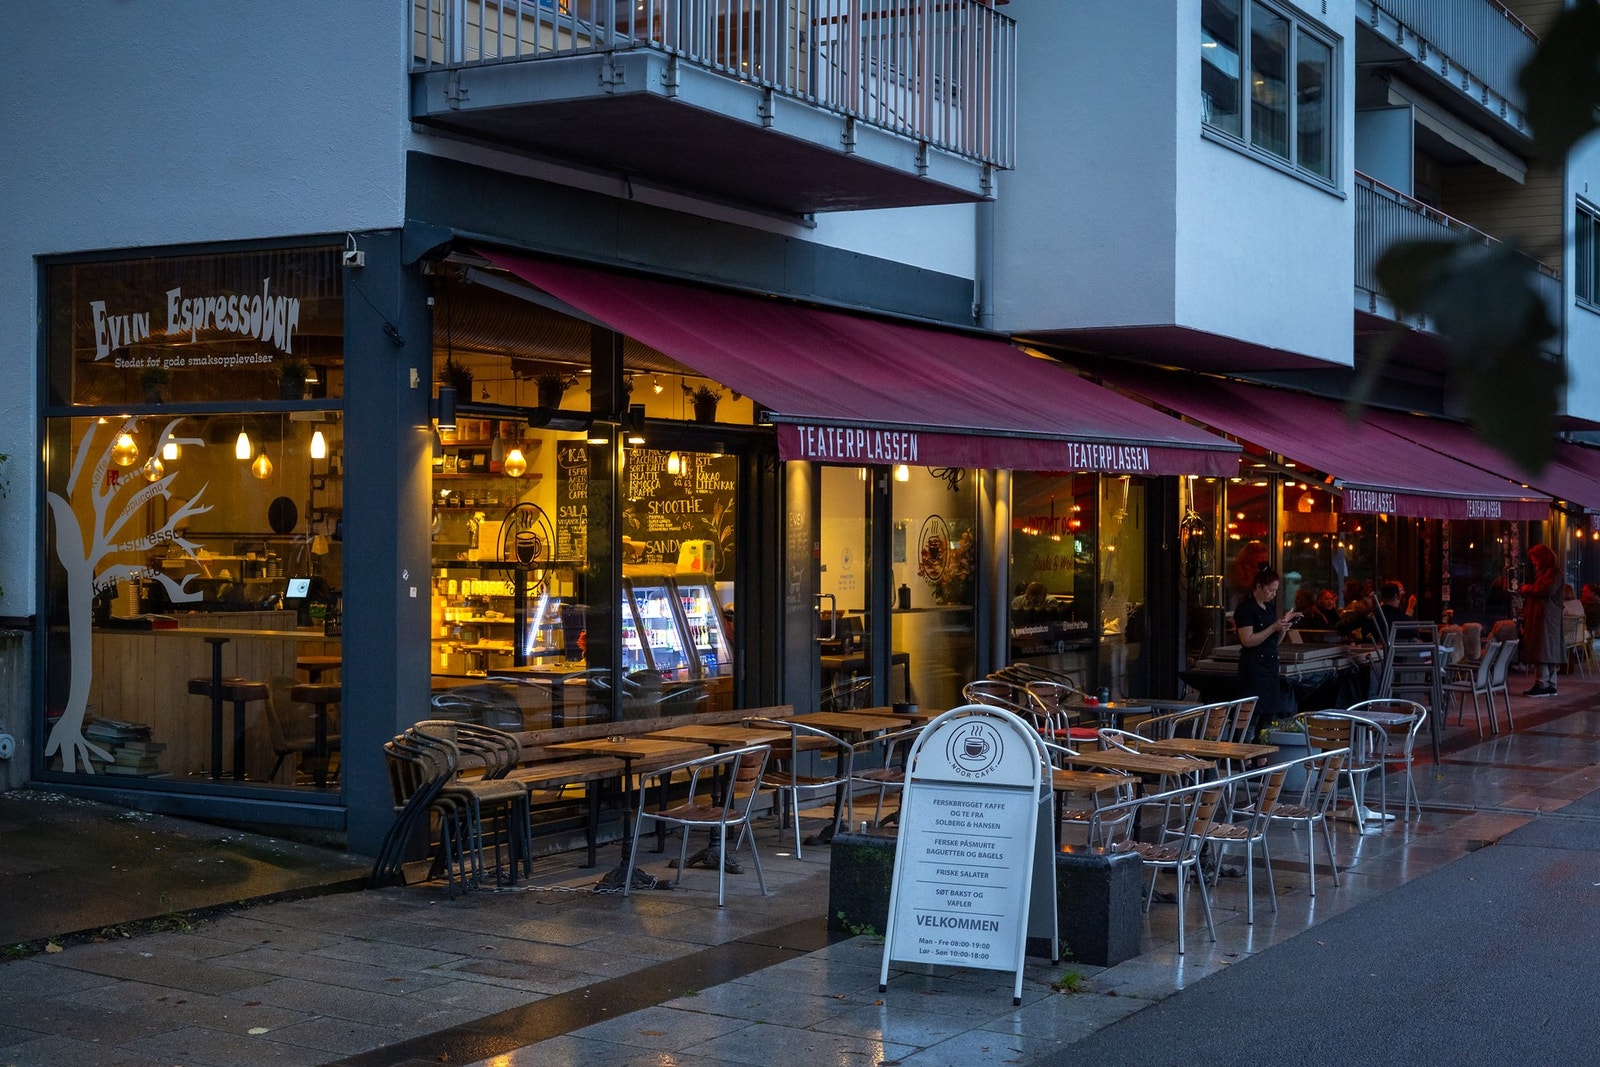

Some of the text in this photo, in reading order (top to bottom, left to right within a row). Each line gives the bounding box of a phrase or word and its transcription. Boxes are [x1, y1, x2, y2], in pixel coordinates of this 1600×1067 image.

[165, 277, 300, 354] Espressobar
[114, 353, 274, 370] Stedet for gode smaksopplevelser
[797, 425, 918, 462] TEATERPLASSEN
[1067, 442, 1149, 471] TEATERPLASSEN
[696, 472, 721, 482] KAKAO
[951, 763, 971, 778] NOOR
[933, 799, 1005, 810] FERSKBRYGGET KAFFE
[935, 819, 965, 827] SOLBERG
[973, 822, 1001, 830] HANSEN
[934, 839, 995, 849] FERSKE PÅSMURTE
[926, 848, 965, 857] BAGUETTER
[978, 851, 1003, 860] BAGELS
[936, 868, 989, 879] FRISKE SALATER
[950, 889, 971, 898] BAKST
[973, 891, 984, 899] OG
[947, 900, 972, 908] VAFLER
[916, 914, 999, 932] VELKOMMEN
[938, 939, 949, 947] Fre
[950, 940, 991, 950] 08:00-19:00
[949, 950, 990, 960] 10:00-18:00
